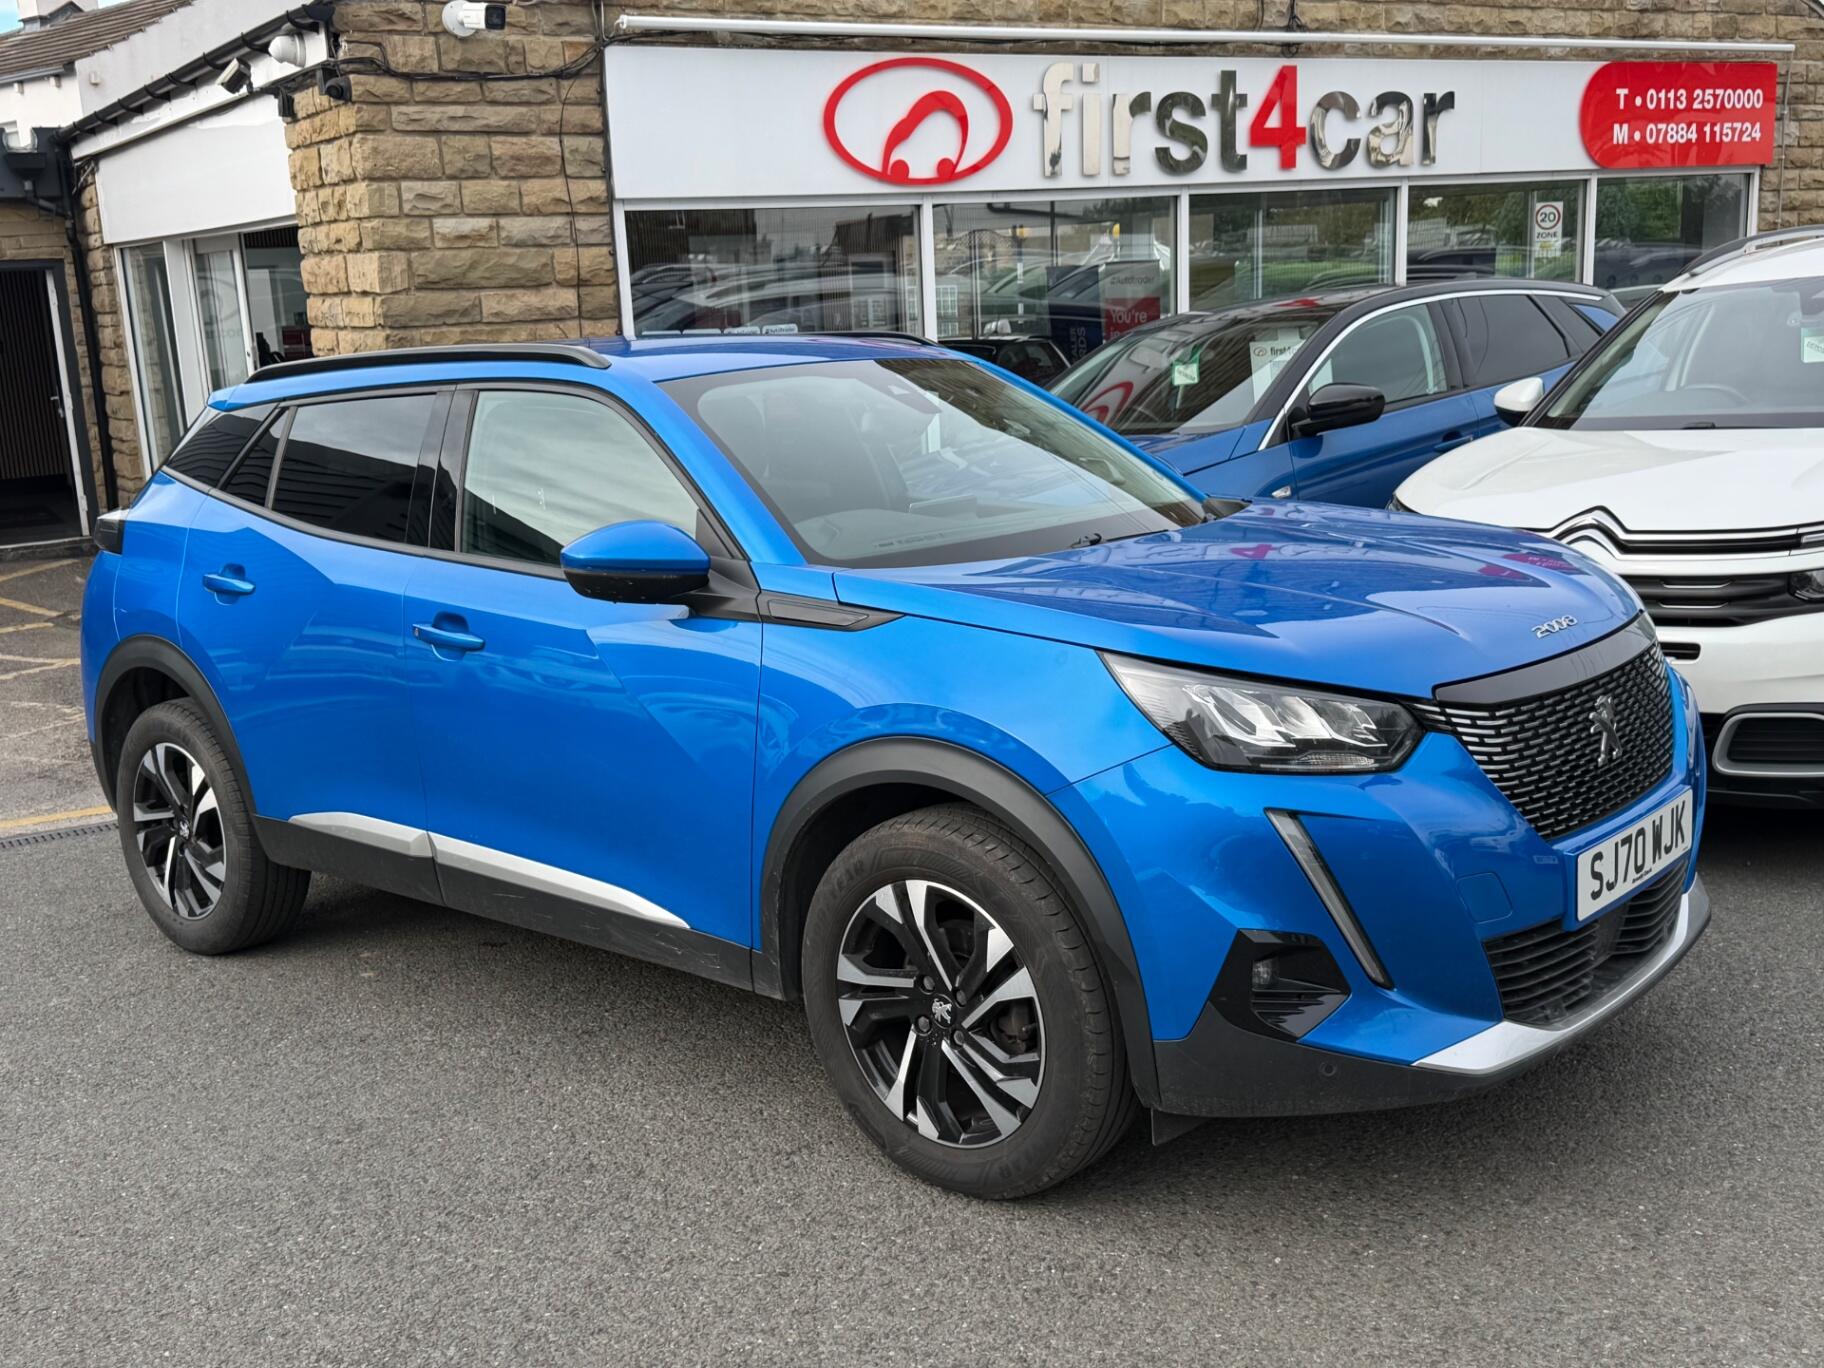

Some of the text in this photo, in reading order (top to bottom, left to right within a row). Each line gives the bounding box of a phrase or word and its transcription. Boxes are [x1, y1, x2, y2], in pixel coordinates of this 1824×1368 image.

[1616, 88, 1763, 109] T 0113 2570000
[1033, 62, 1455, 177] first4car
[1613, 122, 1761, 144] M 07884 115724
[1540, 211, 1557, 223] 20
[1536, 231, 1558, 239] ZONE
[1110, 308, 1148, 324] You're
[1531, 614, 1578, 638] 2008
[1590, 799, 1686, 901] SJ70 WJK
